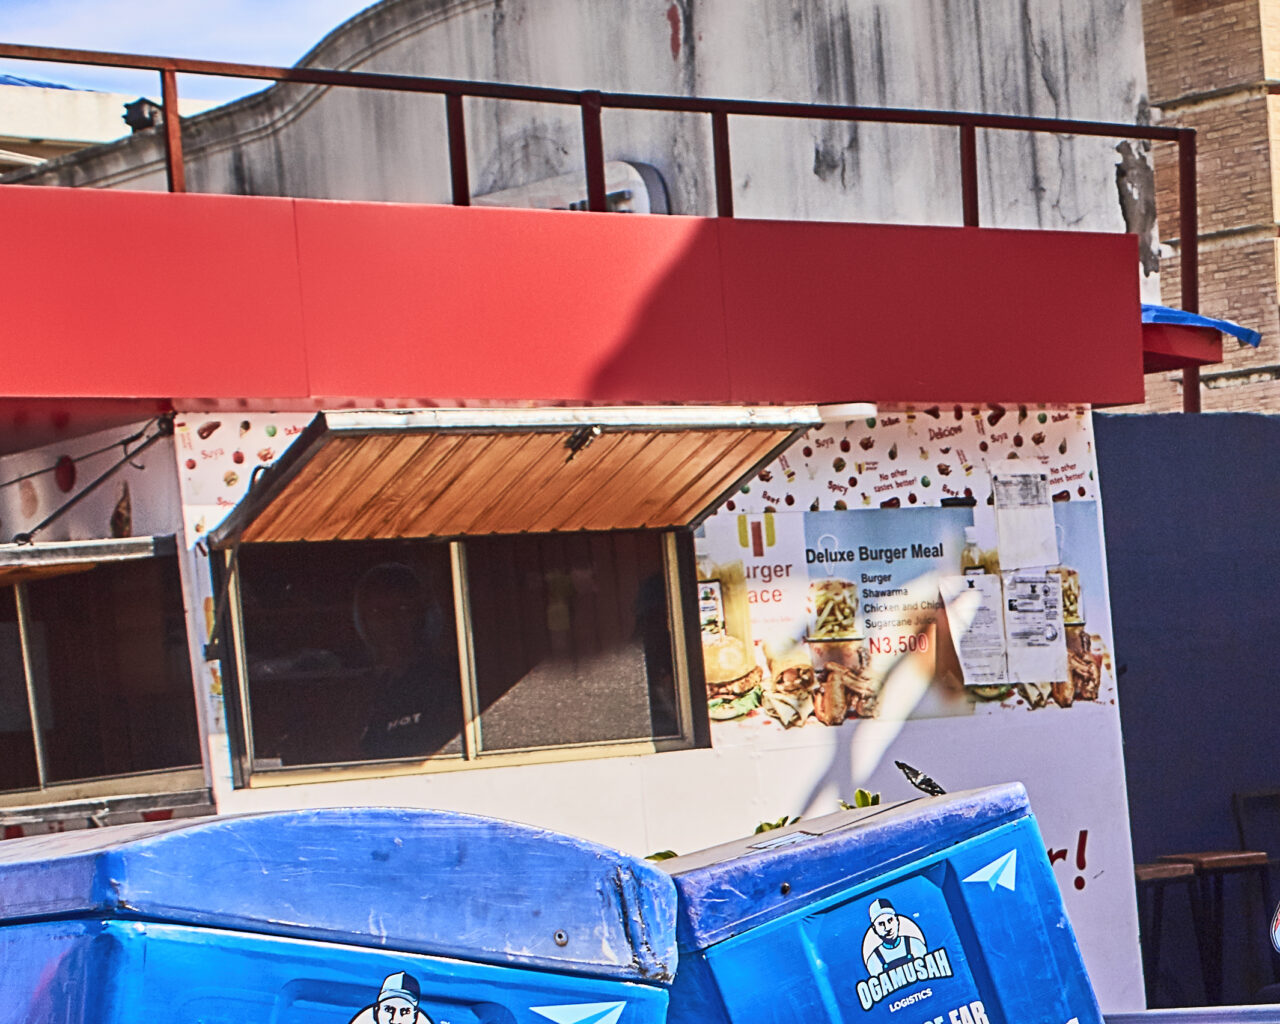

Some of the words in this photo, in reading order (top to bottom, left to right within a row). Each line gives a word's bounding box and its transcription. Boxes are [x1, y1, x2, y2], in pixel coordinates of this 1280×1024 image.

[805, 548, 855, 564] Deluxe
[859, 546, 907, 564] Burger
[911, 543, 943, 560] Meal
[861, 573, 892, 585] Burger
[862, 587, 909, 599] Shawarma
[864, 602, 900, 614] Chicken
[901, 601, 919, 612] and
[865, 618, 913, 630] Sugarcane
[868, 632, 929, 656] N3,500
[857, 948, 952, 1010] OGAMUSAH
[889, 989, 932, 1012] LOGISTICS
